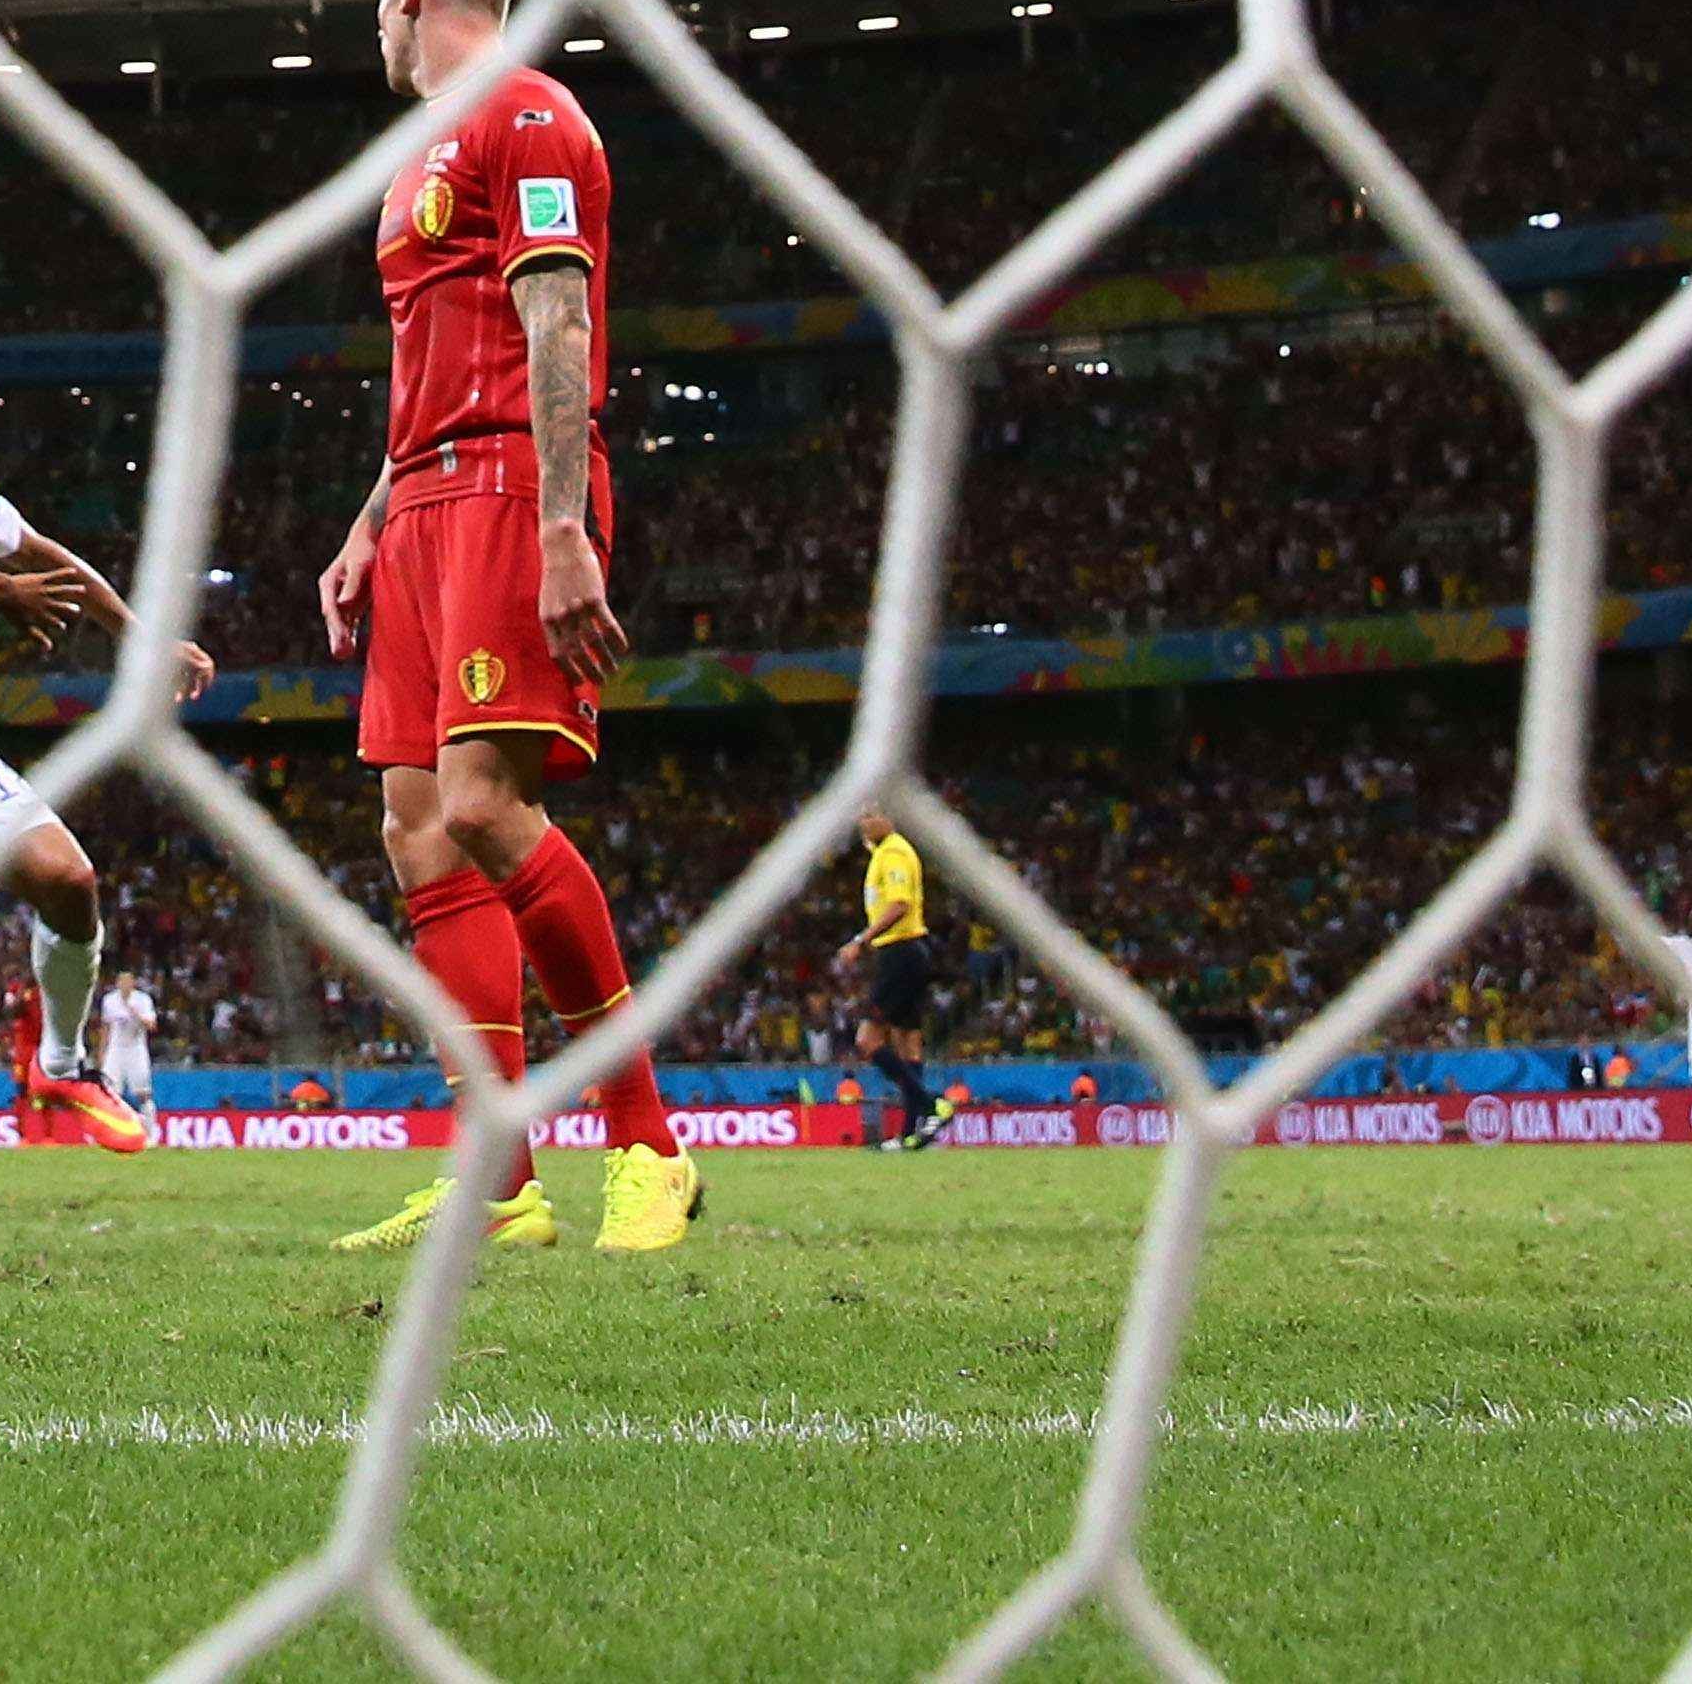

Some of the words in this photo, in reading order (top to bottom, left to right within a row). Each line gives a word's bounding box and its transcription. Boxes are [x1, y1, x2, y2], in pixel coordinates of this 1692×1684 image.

[165, 1116, 234, 1149] KIA
[243, 1115, 410, 1149] MOTORS
[665, 1110, 798, 1146] OTORS
[1511, 1099, 1554, 1140] KIA
[1557, 1096, 1663, 1142] MOTORS
